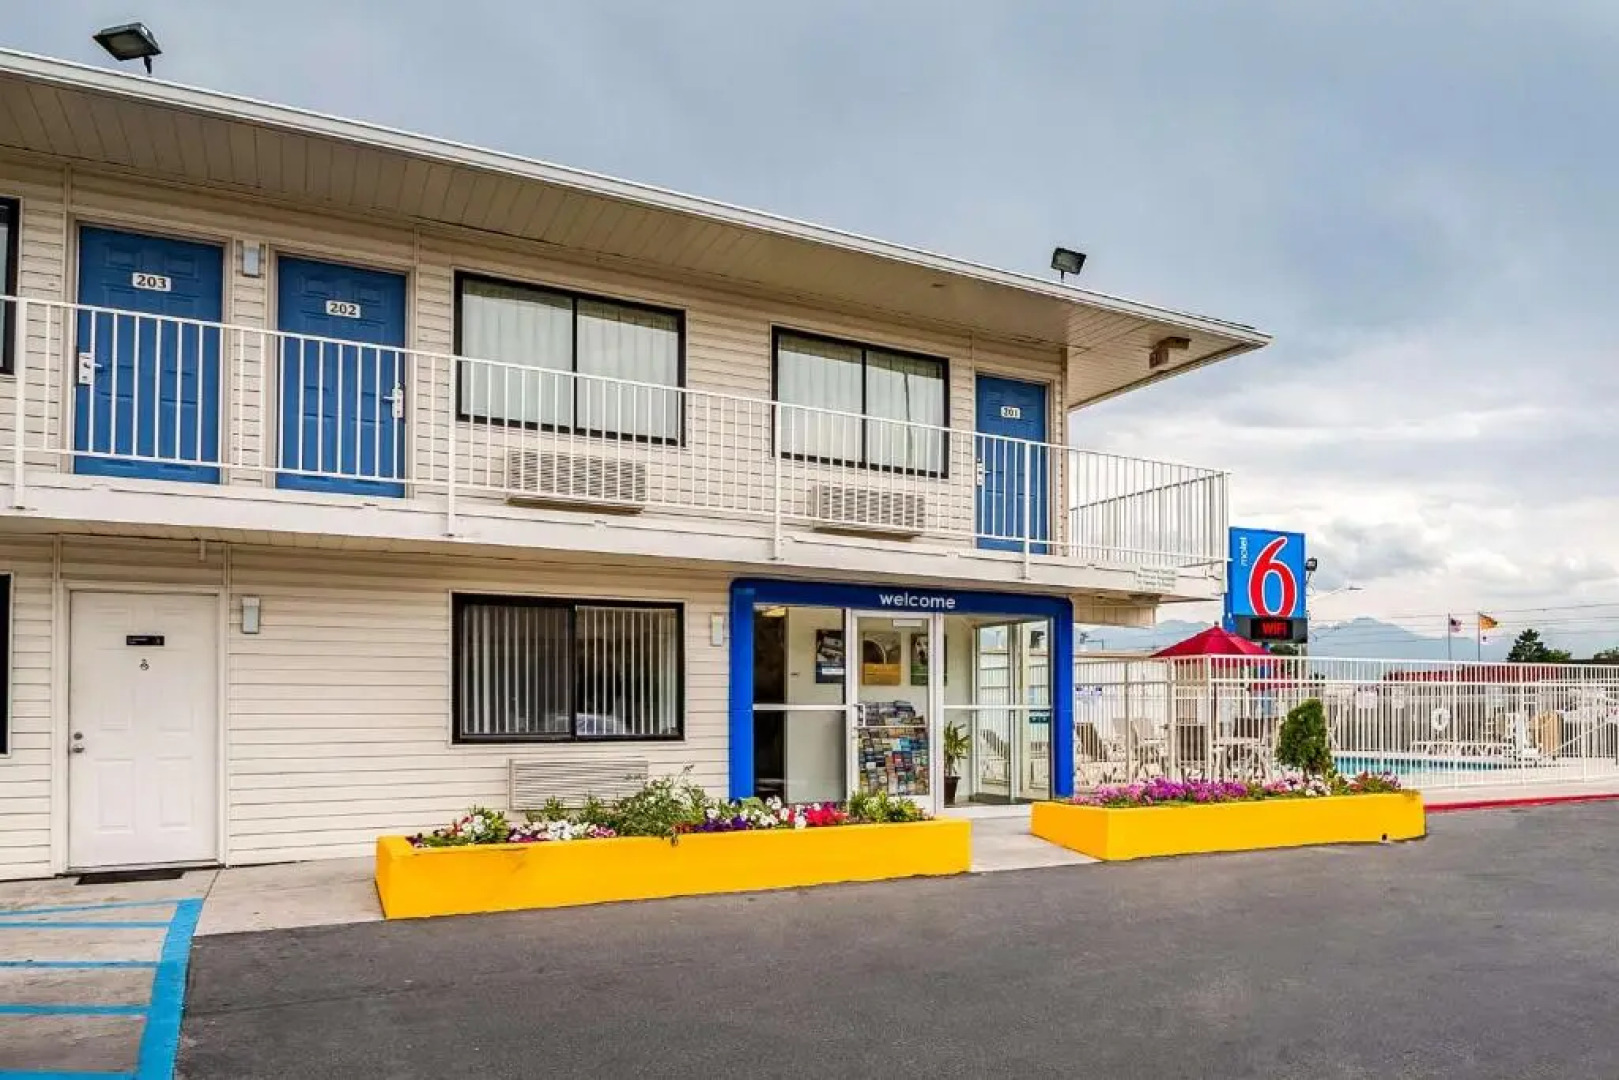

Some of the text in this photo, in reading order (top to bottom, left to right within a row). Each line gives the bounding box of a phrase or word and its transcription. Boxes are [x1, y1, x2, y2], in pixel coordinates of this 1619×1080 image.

[136, 275, 167, 288] 203
[331, 302, 357, 315] 202
[1004, 407, 1018, 417] 201
[1240, 538, 1248, 566] motel
[1248, 536, 1297, 617] 6
[879, 592, 956, 609] welcome
